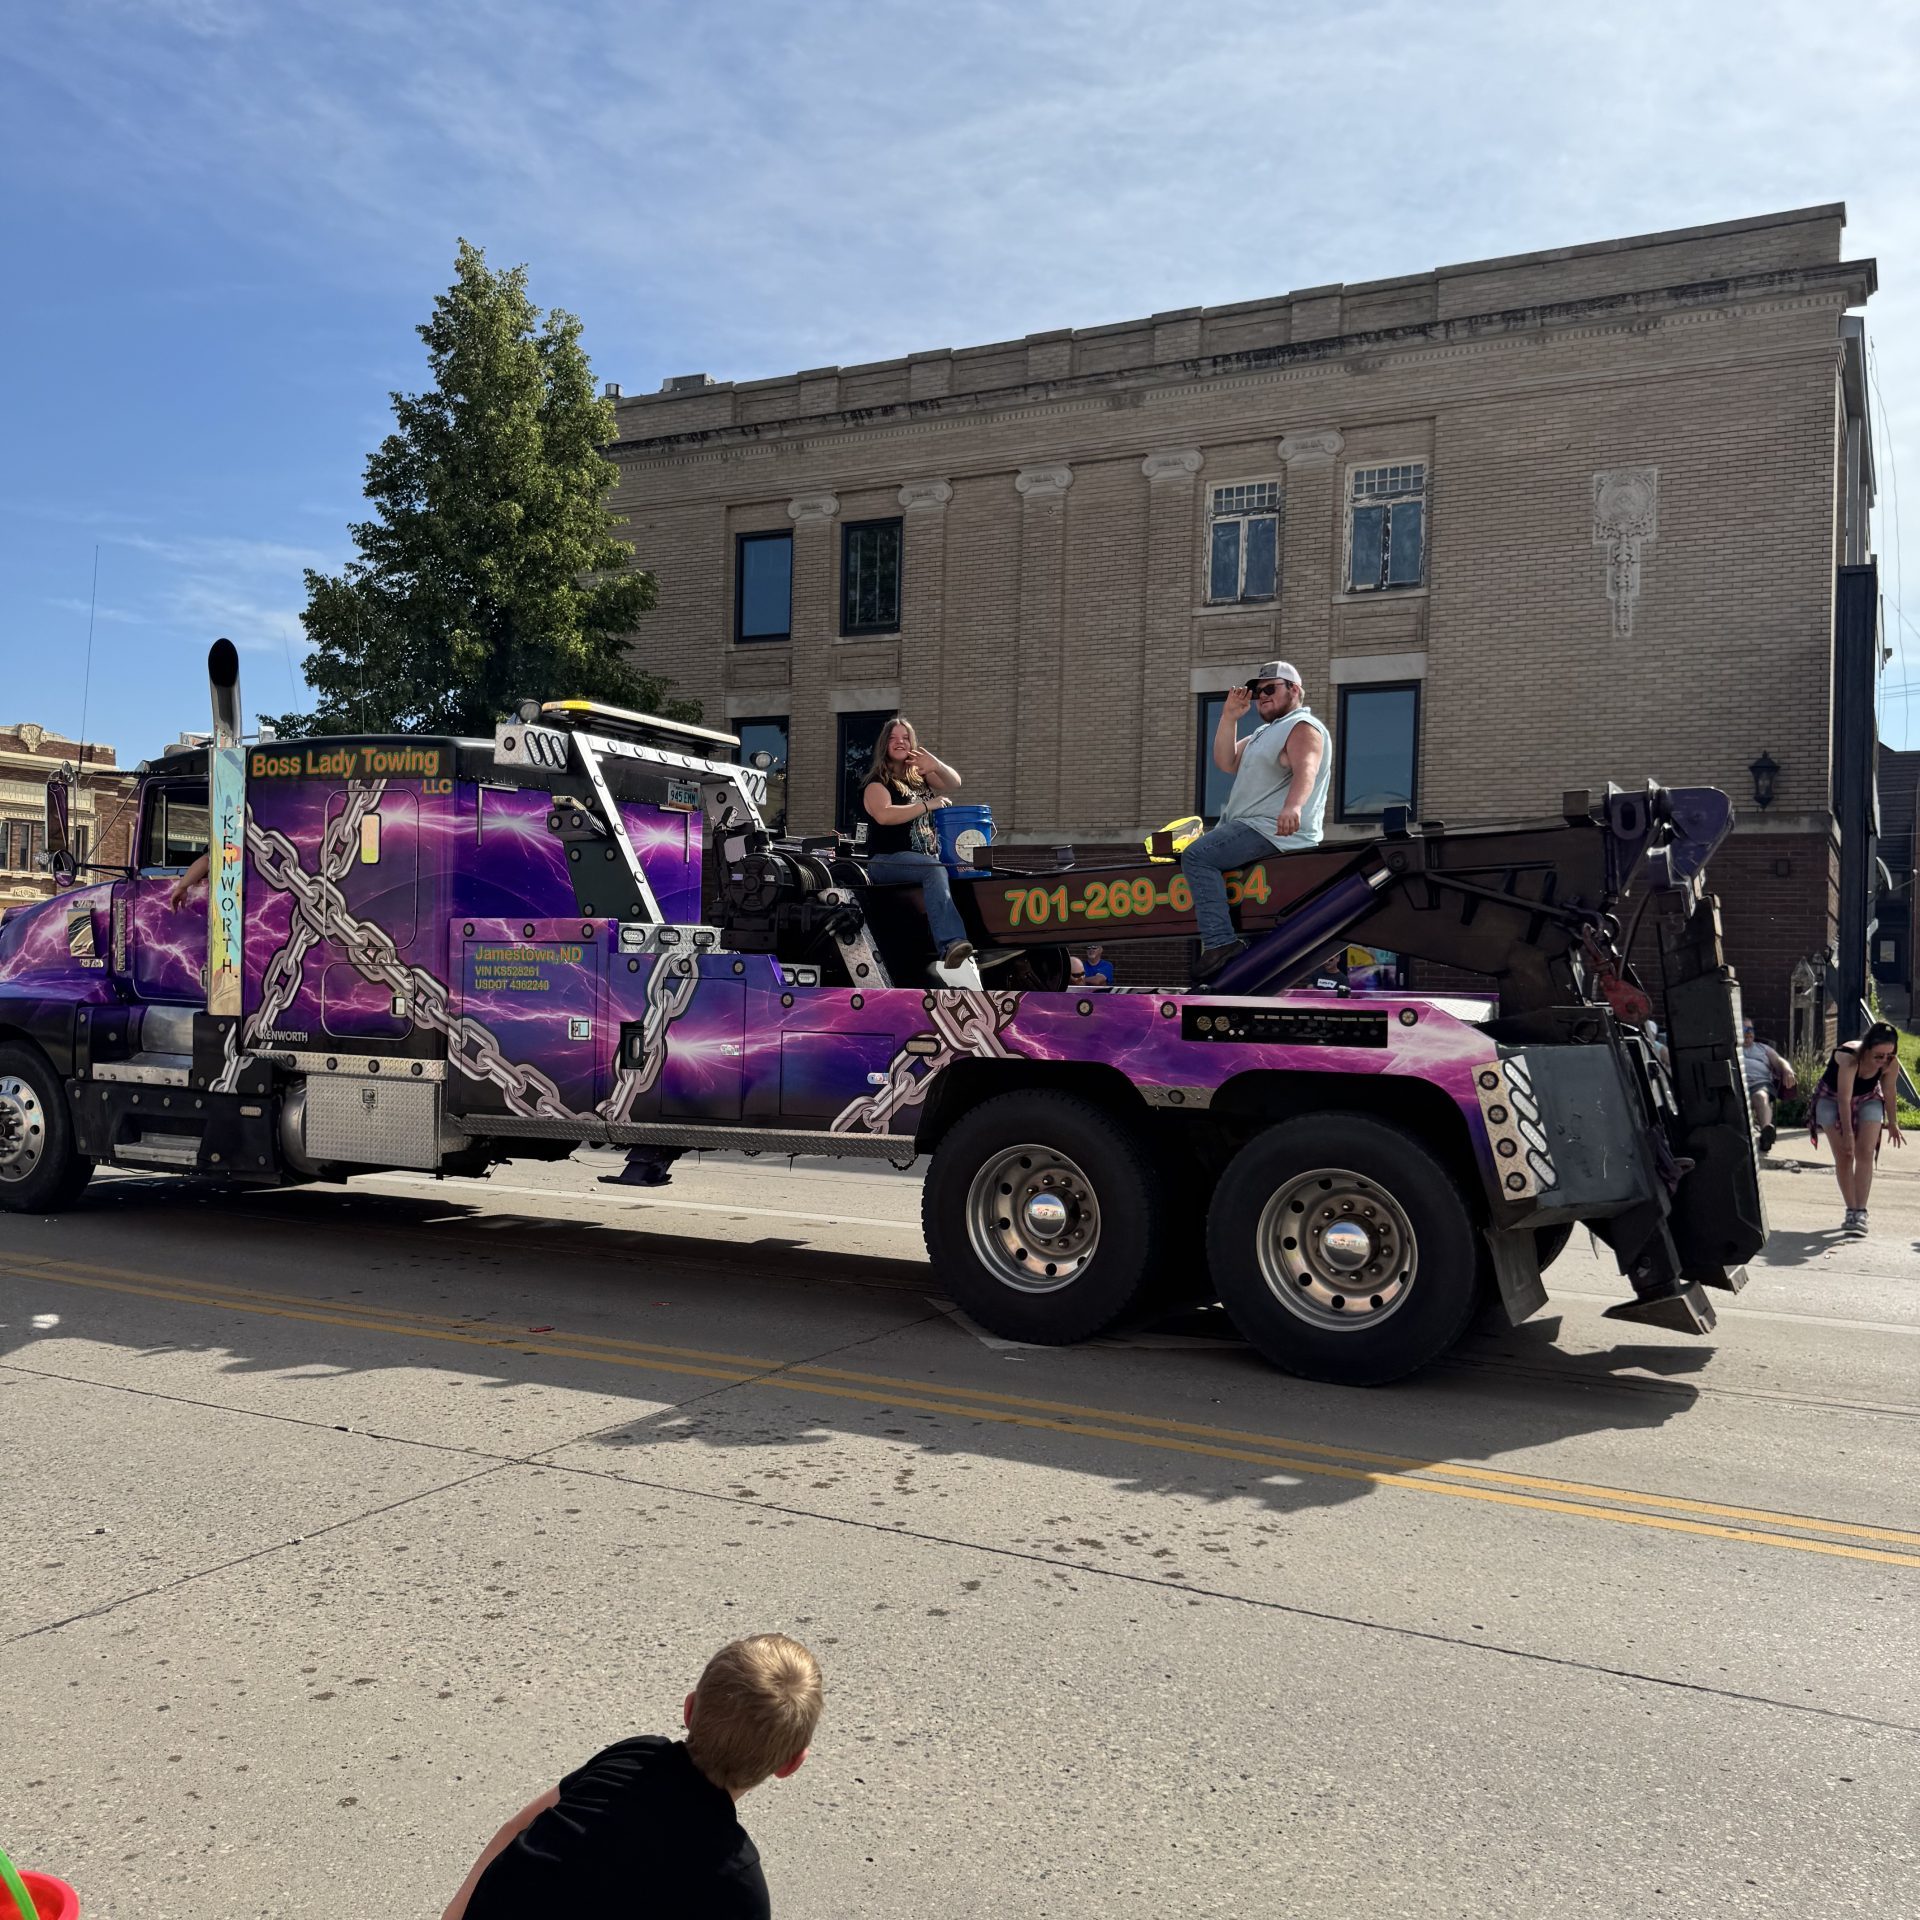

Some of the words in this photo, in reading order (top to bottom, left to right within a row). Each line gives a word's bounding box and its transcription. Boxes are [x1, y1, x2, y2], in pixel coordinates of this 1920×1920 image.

[252, 753, 301, 777] Boss
[306, 748, 357, 779] Lady
[361, 746, 440, 776] Towing
[422, 779, 453, 794] LLC
[220, 814, 235, 974] KENWORTH
[1004, 864, 1272, 926] 701-269-654
[475, 965, 492, 977] VIN
[475, 979, 507, 990] USDOT
[262, 1030, 309, 1042] KENWORTH
